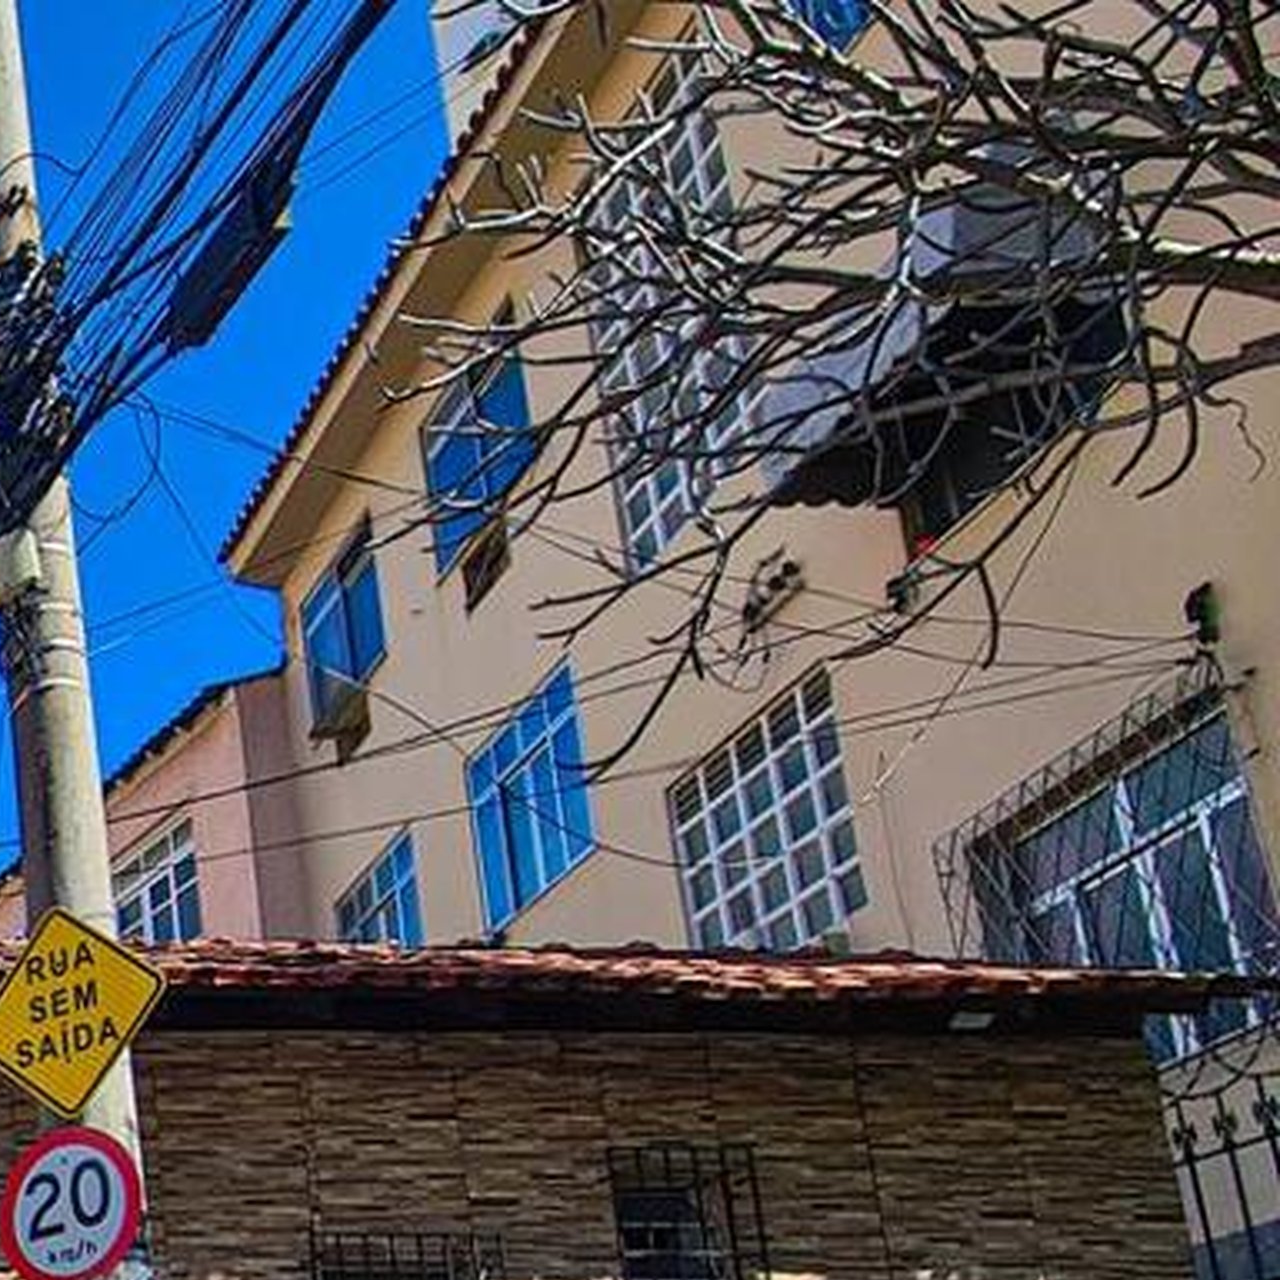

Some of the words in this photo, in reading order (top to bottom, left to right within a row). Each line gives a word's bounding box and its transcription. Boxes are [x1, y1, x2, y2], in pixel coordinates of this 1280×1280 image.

[25, 941, 96, 985] RUA
[29, 980, 99, 1024] SEM
[24, 1158, 111, 1243] 20
[46, 1238, 98, 1266] km/h
